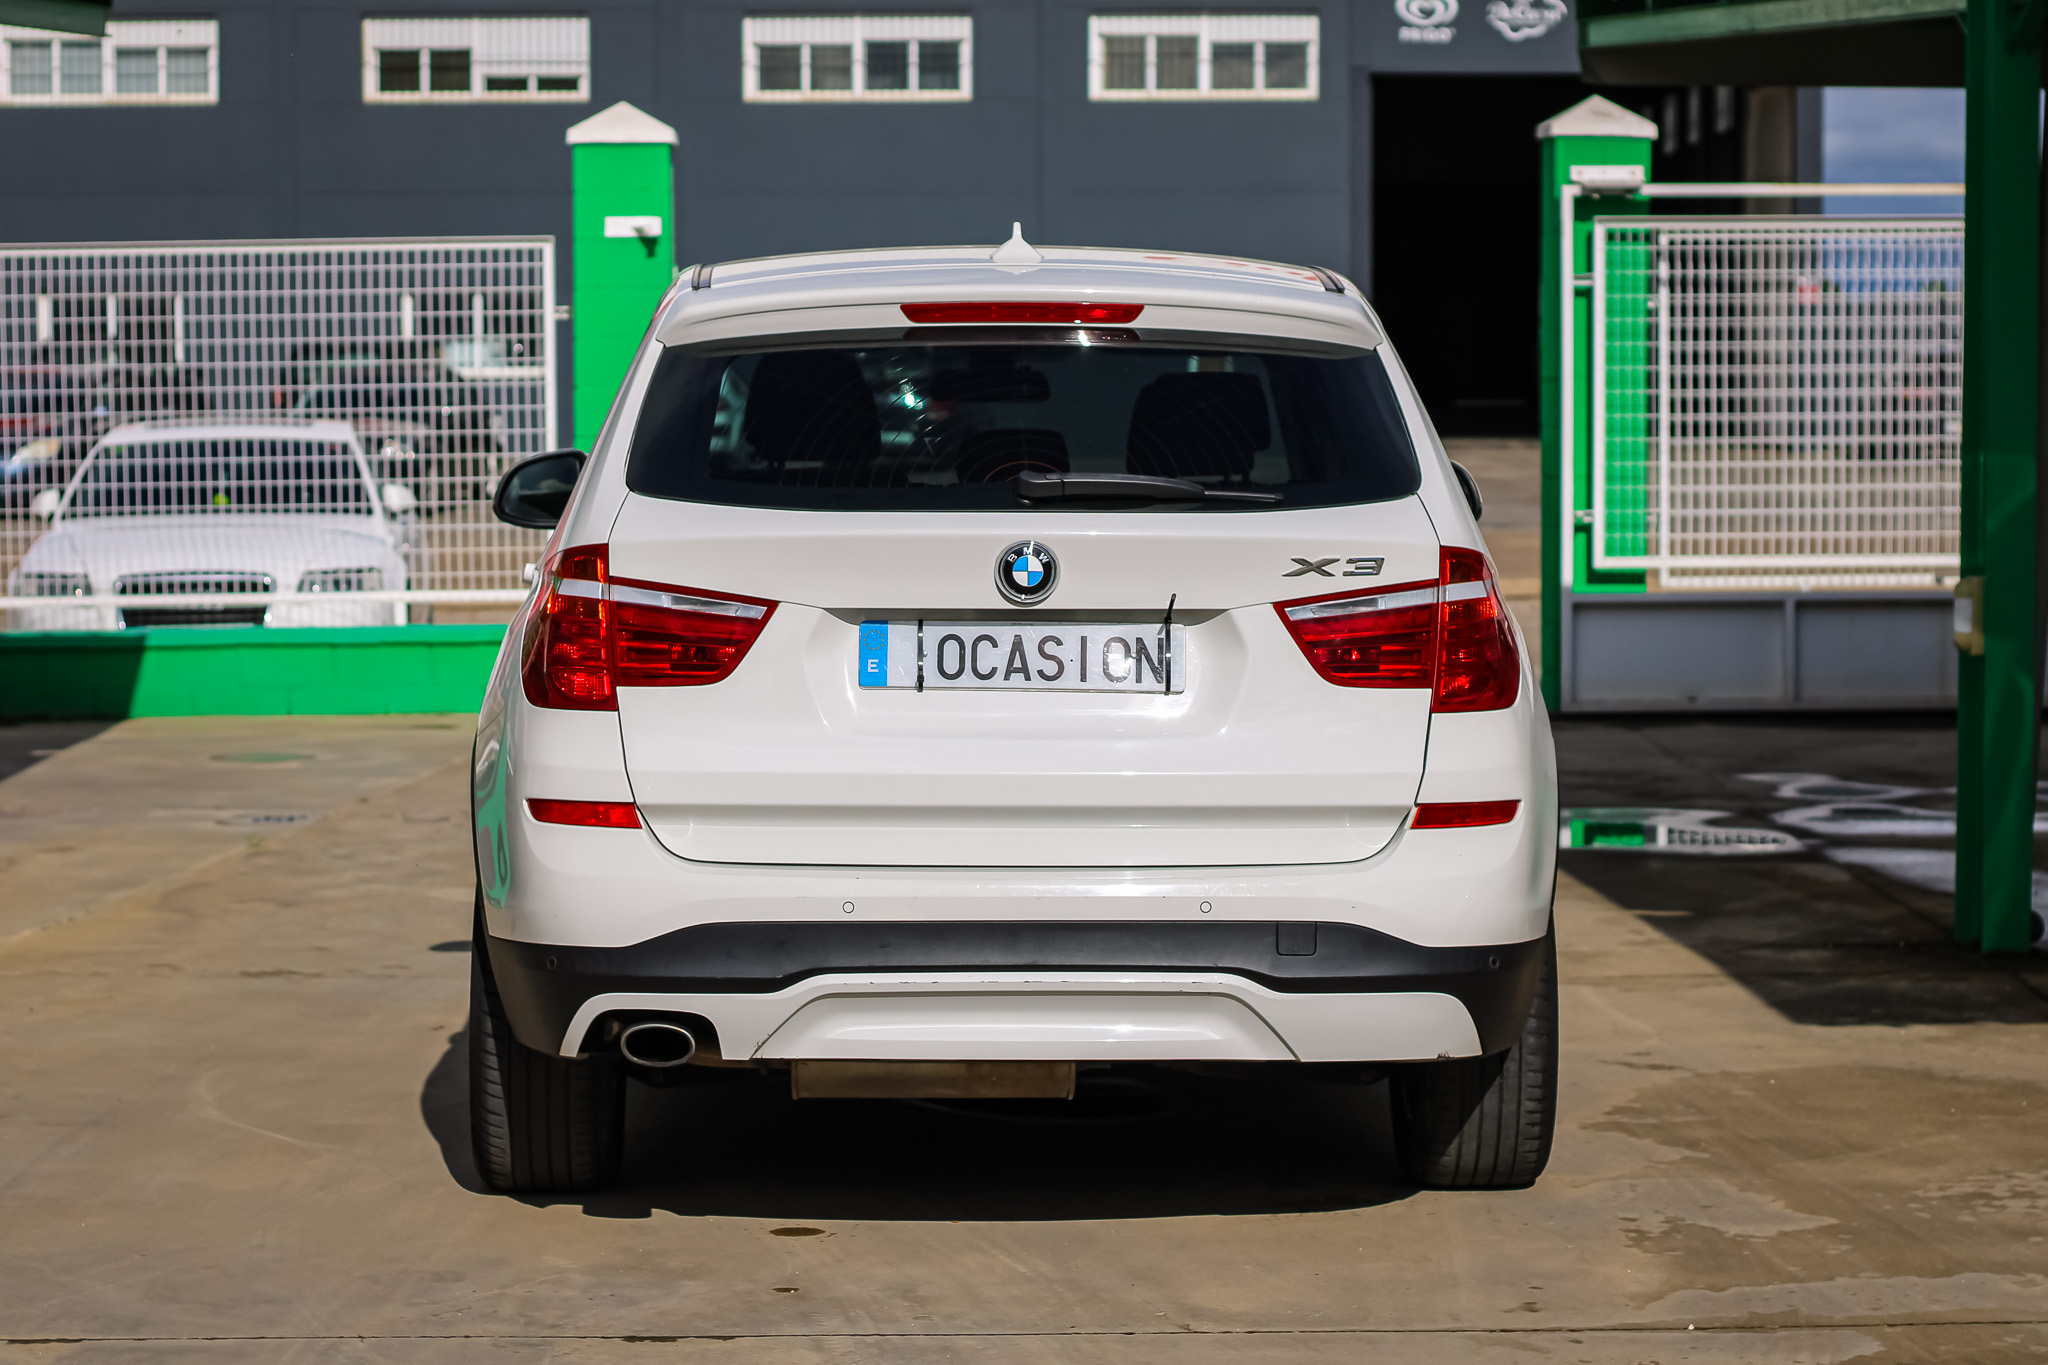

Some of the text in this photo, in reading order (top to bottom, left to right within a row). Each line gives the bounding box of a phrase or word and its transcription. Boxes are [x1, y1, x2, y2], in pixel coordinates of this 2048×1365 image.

[1007, 546, 1049, 563] BMW
[1281, 557, 1385, 577] X3
[867, 659, 879, 673] E
[937, 633, 1164, 684] OCASION
